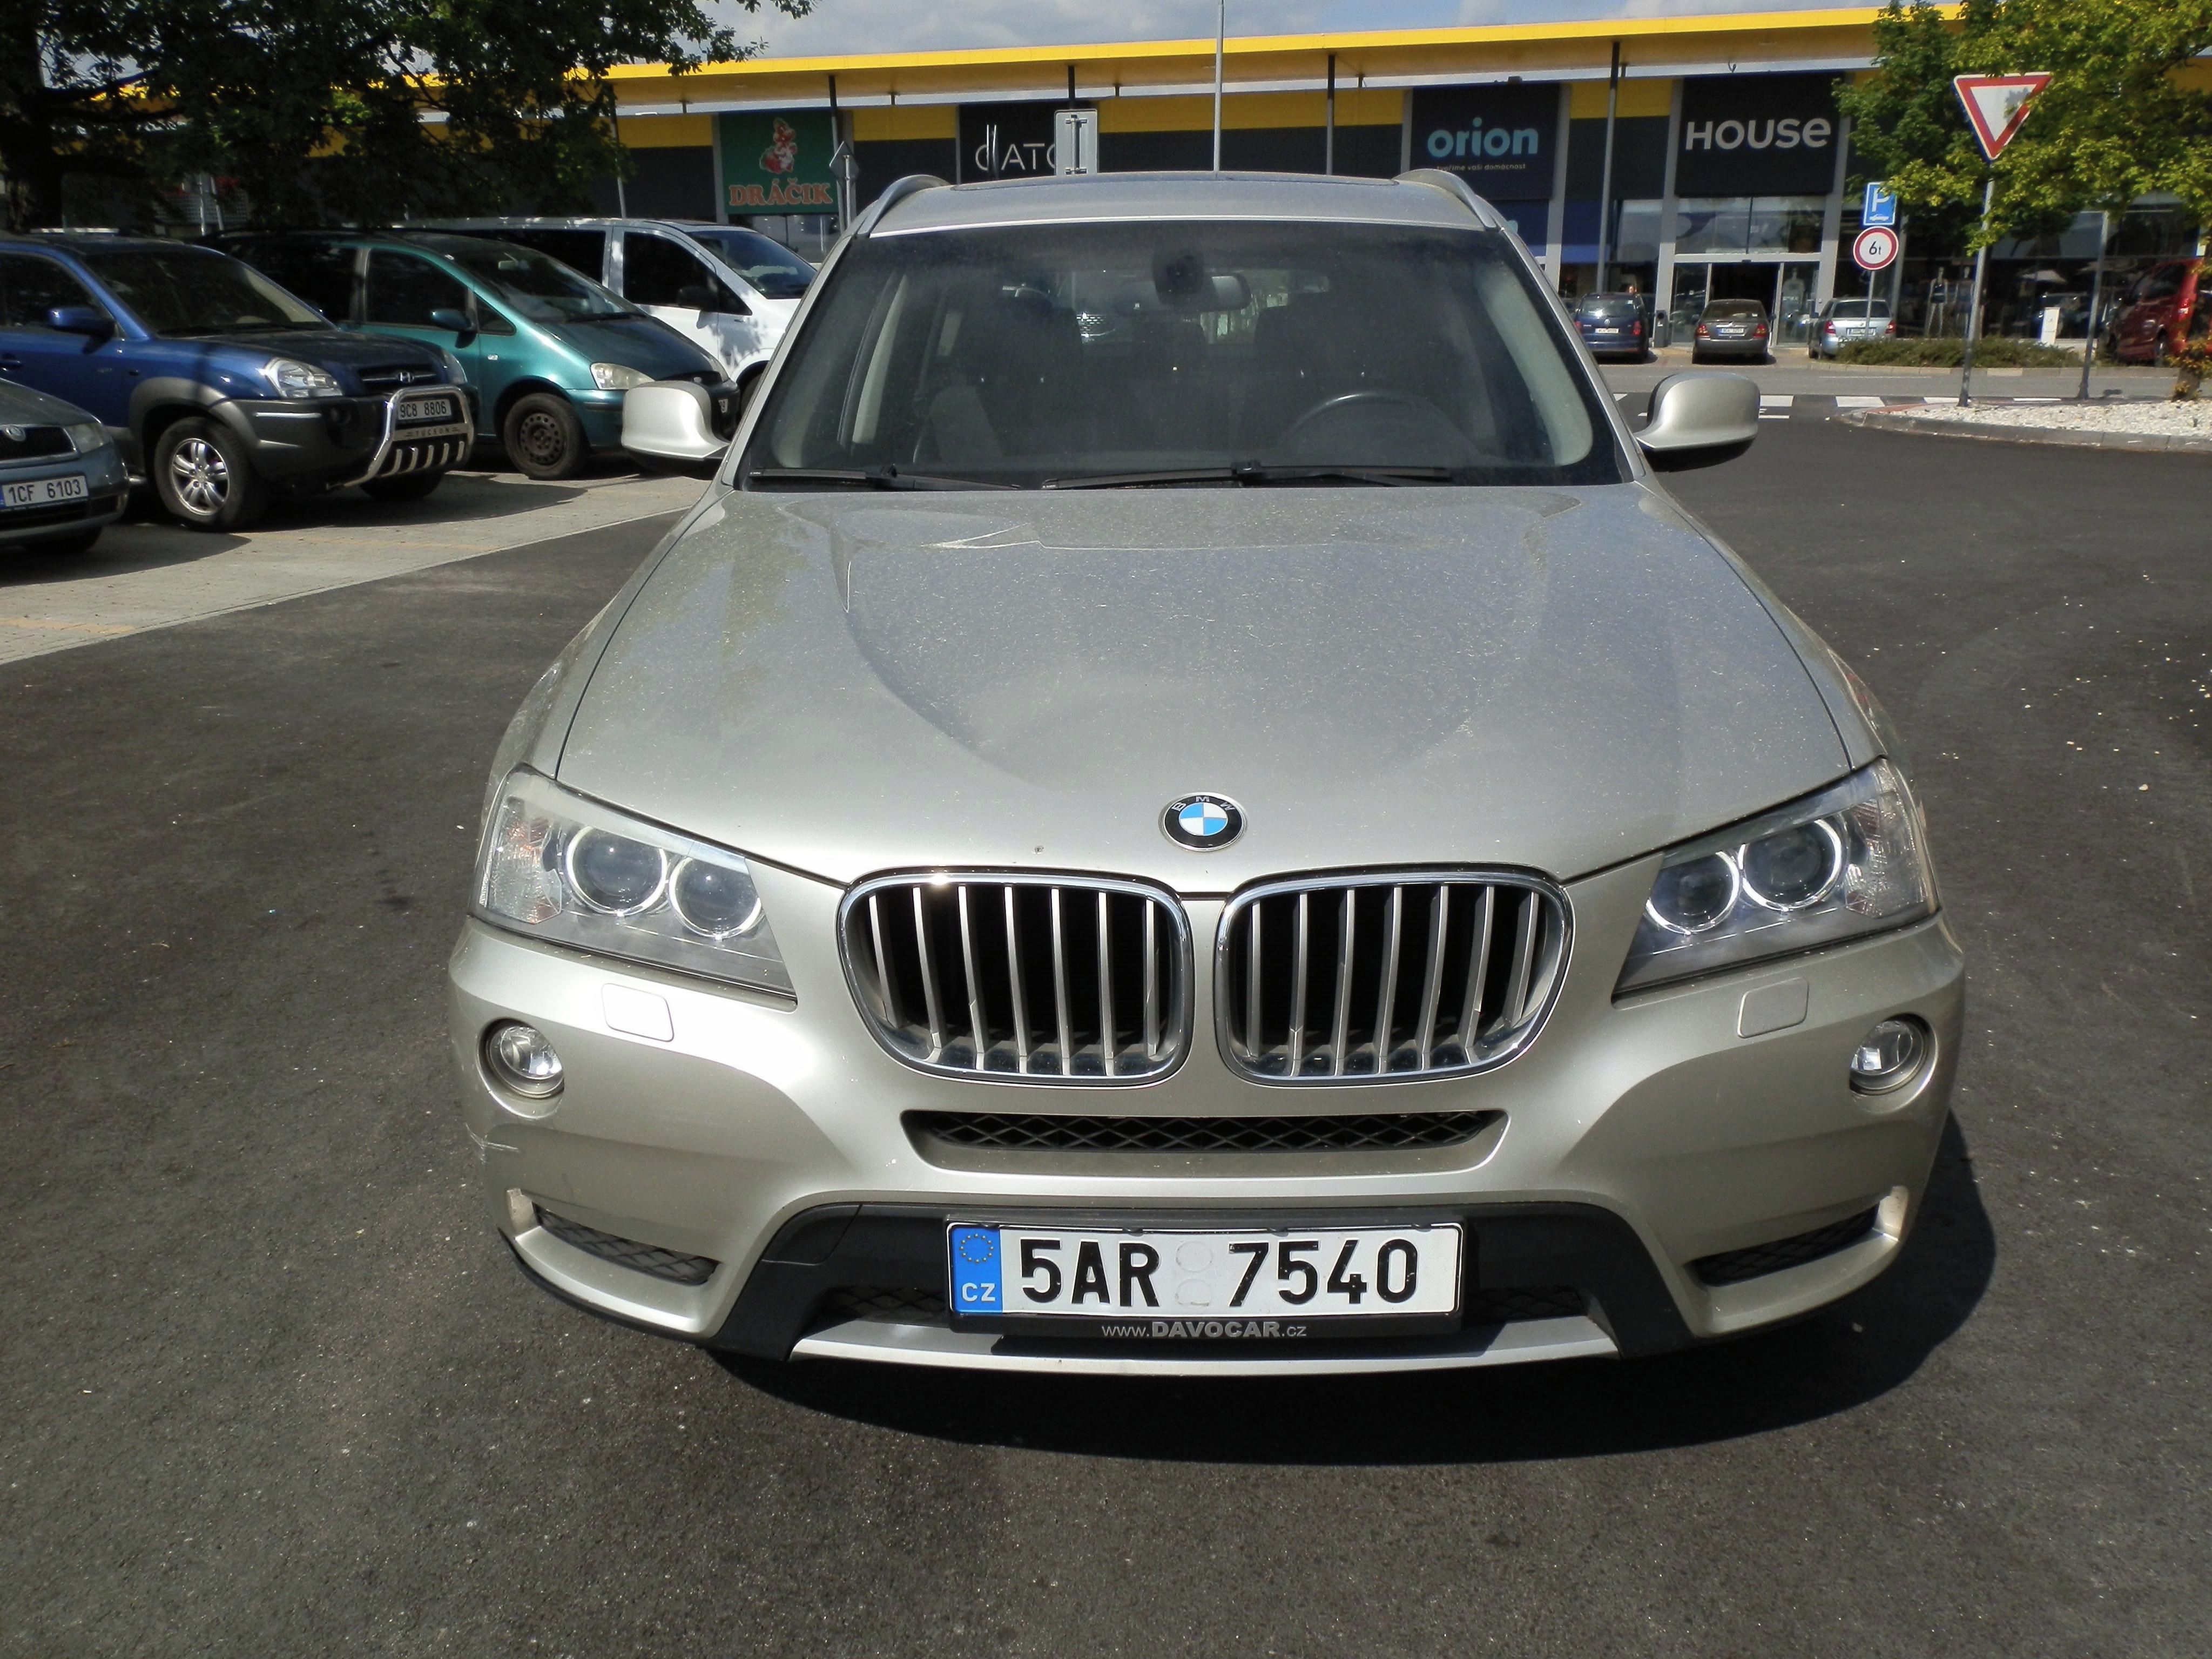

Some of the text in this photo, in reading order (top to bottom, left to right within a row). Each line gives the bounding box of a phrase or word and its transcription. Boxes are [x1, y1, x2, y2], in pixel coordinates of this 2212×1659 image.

[1427, 117, 1539, 157] orion
[729, 178, 833, 206] DRÁČIK
[424, 401, 447, 415] 8806
[416, 428, 450, 437] TUCSON
[9, 480, 81, 503] 1CF 6103
[1171, 797, 1236, 811] BMW
[1020, 1237, 1418, 1307] 5AR 7540
[962, 1283, 996, 1302] CZ
[1102, 1321, 1307, 1338] www.DAVOCAR.cz
